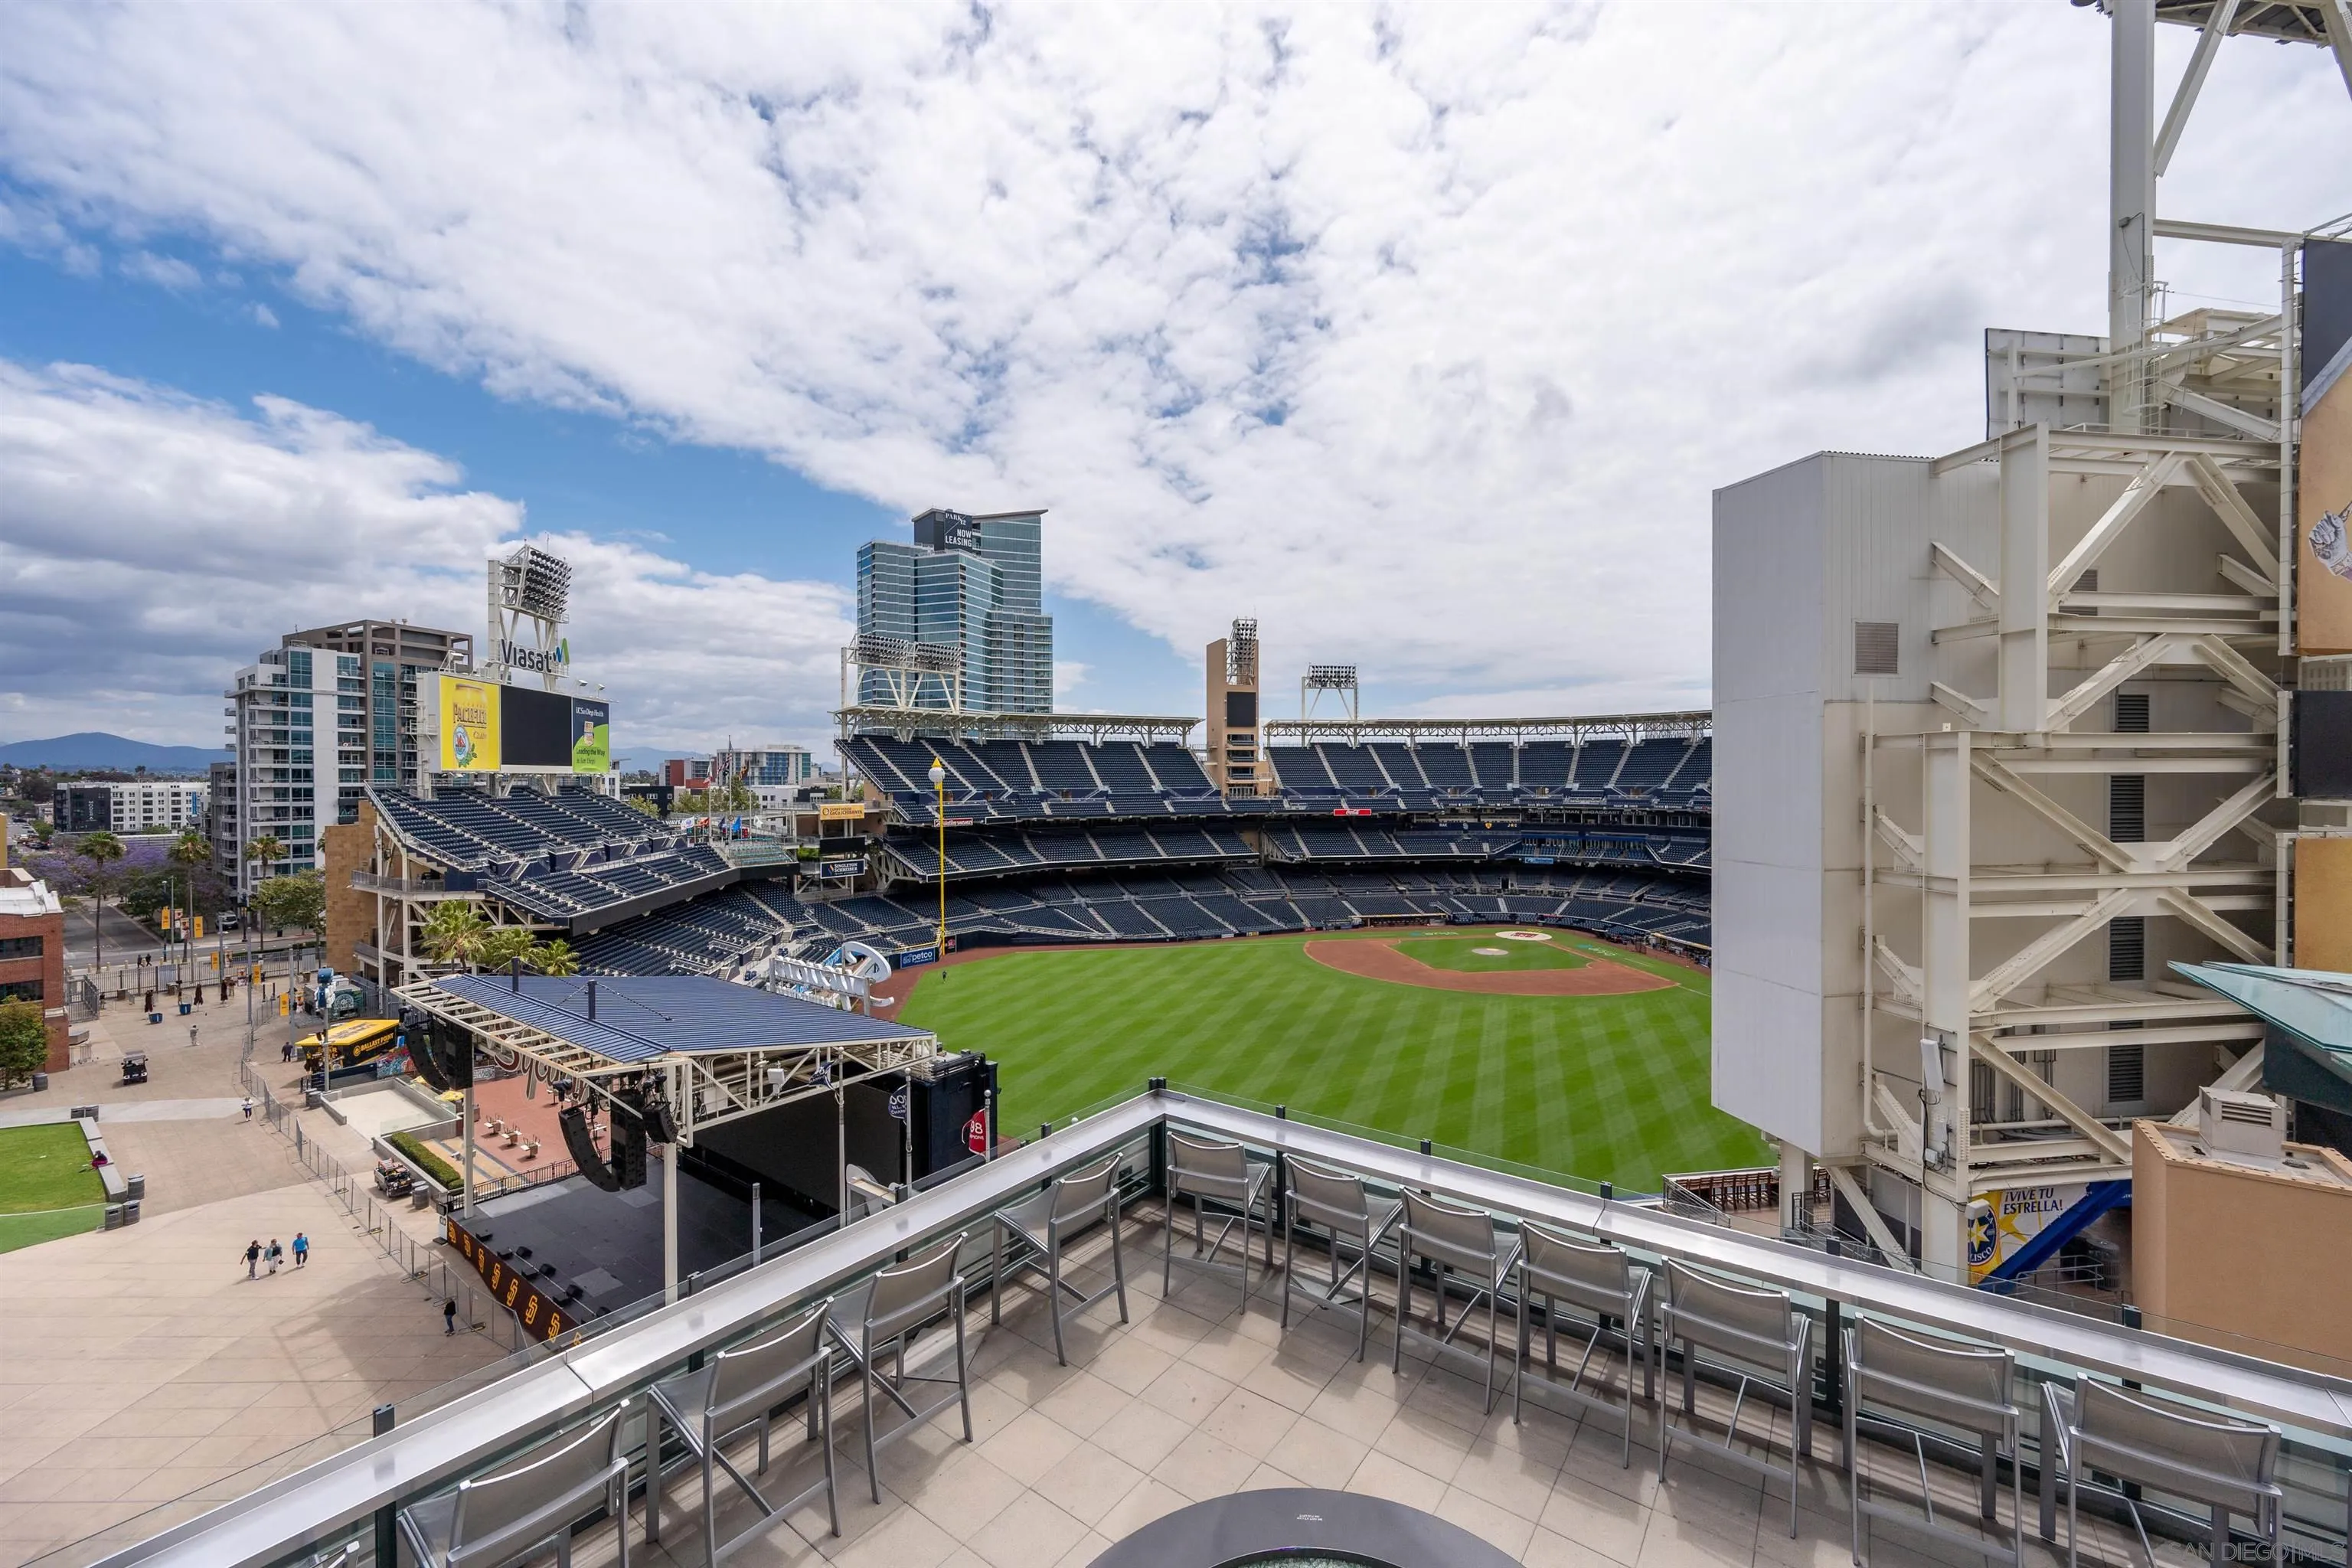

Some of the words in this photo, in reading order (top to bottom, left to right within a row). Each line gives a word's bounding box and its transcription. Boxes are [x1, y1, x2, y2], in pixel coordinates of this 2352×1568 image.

[945, 535, 972, 547] LEASING
[957, 529, 972, 538] NOW
[501, 639, 552, 673] Viasat
[912, 952, 933, 962] petco
[361, 1037, 381, 1051] BALLAST
[381, 1032, 394, 1044] POINT
[2005, 1191, 2036, 1202] ¡VIVE
[2039, 1187, 2054, 1200] TU
[2004, 1199, 2063, 1215] ESTRELLA!
[1970, 1246, 1992, 1262] LISCO
